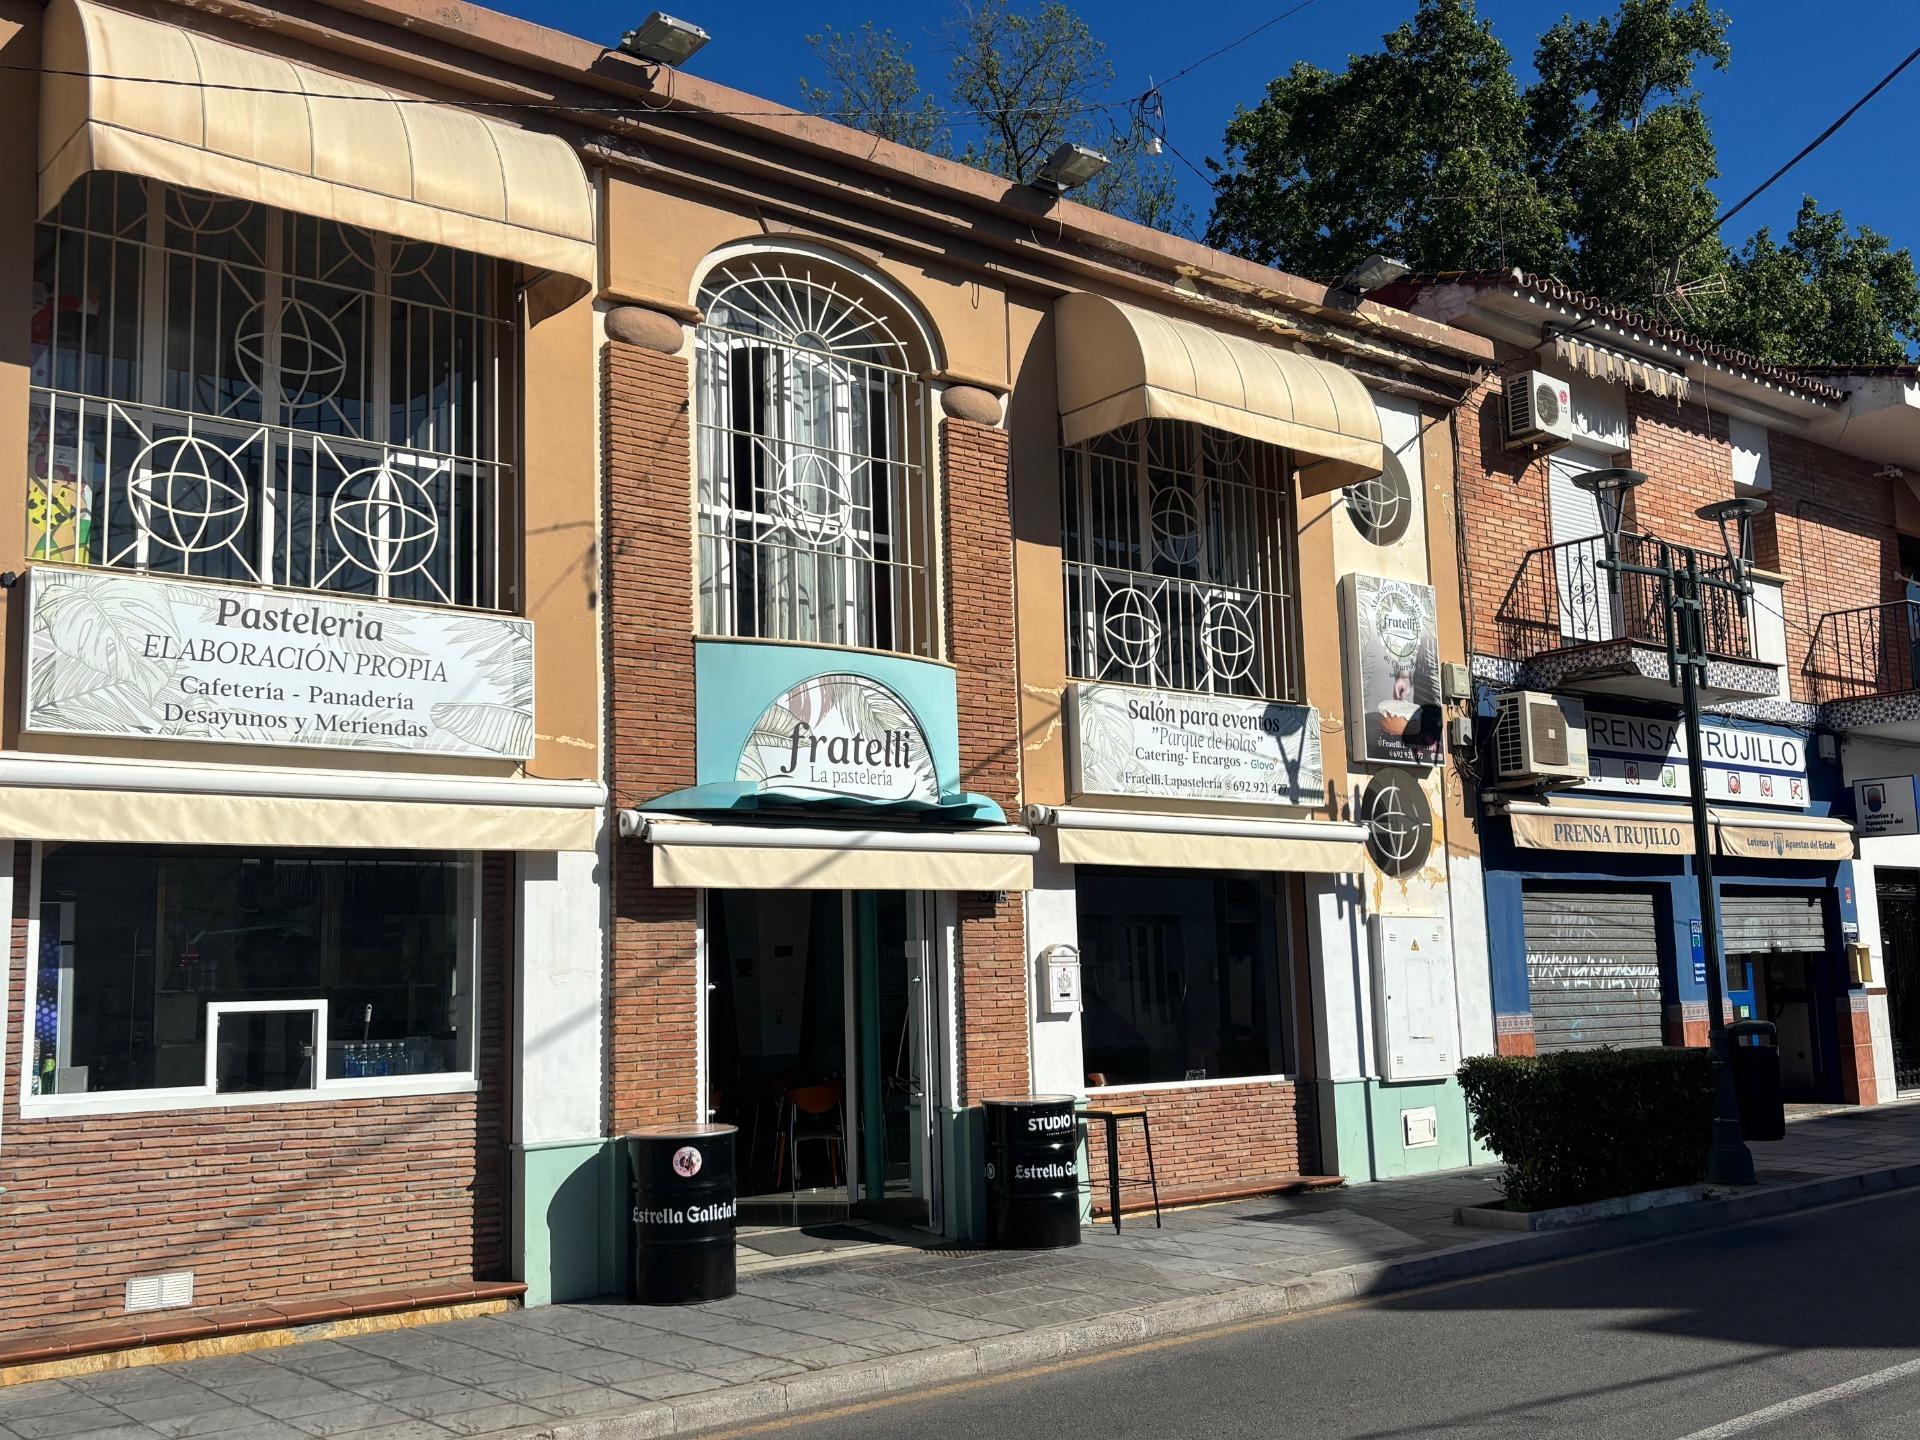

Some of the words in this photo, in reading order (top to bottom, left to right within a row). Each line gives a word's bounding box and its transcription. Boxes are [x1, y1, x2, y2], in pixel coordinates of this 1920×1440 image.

[215, 597, 384, 642] Pasteleria
[1383, 613, 1416, 631] fratelli
[143, 633, 350, 675] ELABORACIÓN
[353, 653, 449, 683] PROPIA
[180, 675, 285, 701] Cafetería
[308, 685, 414, 711] Panadería
[164, 702, 288, 730] Desayunos
[294, 716, 307, 734] y
[314, 713, 428, 738] Meriendas
[1128, 699, 1176, 724] Salón
[1180, 707, 1218, 729] para
[1222, 712, 1280, 733] eventos
[780, 721, 911, 774] fratelli
[1207, 731, 1222, 747] de
[1699, 729, 1798, 767] RUJILLO
[1192, 751, 1242, 769] Encargos
[1250, 759, 1276, 771] Glovo
[810, 765, 828, 783] La
[832, 767, 893, 788] pastelería
[1233, 780, 1250, 793] 692
[1253, 781, 1269, 794] 921
[1271, 783, 1288, 795] 477
[1553, 823, 1612, 843] PRENSA
[1614, 825, 1681, 849] TRUJILLO
[1866, 825, 1887, 833] Estado
[1785, 839, 1809, 851] Apuestas
[1809, 840, 1818, 849] del
[1818, 840, 1837, 850] Estado
[1027, 1114, 1071, 1132] STUDIO
[1014, 1163, 1064, 1179] Estrella
[632, 1205, 684, 1224] Estrella
[686, 1201, 732, 1223] Galicia
